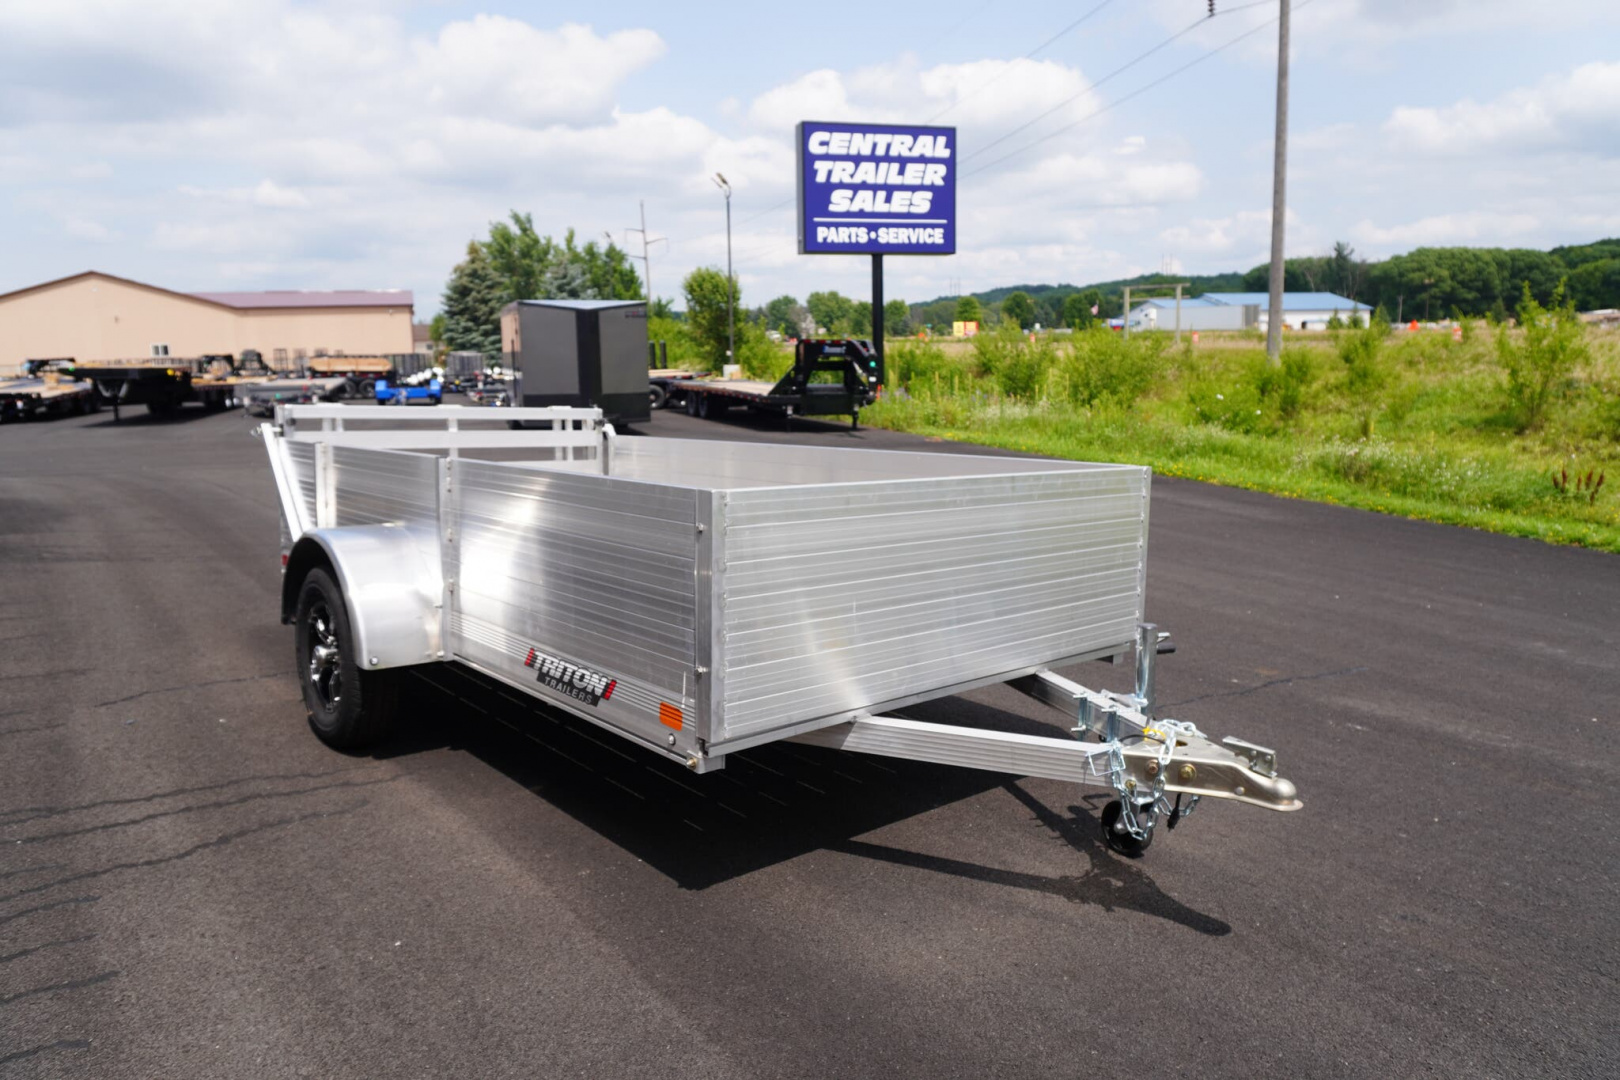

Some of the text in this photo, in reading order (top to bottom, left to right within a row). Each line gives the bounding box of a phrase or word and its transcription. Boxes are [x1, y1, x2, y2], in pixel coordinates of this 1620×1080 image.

[808, 131, 951, 158] CENTRAL
[813, 160, 947, 186] TRAILER
[828, 189, 933, 213] SALES
[533, 651, 608, 696] TRITON
[544, 677, 593, 704] TRAILERS
